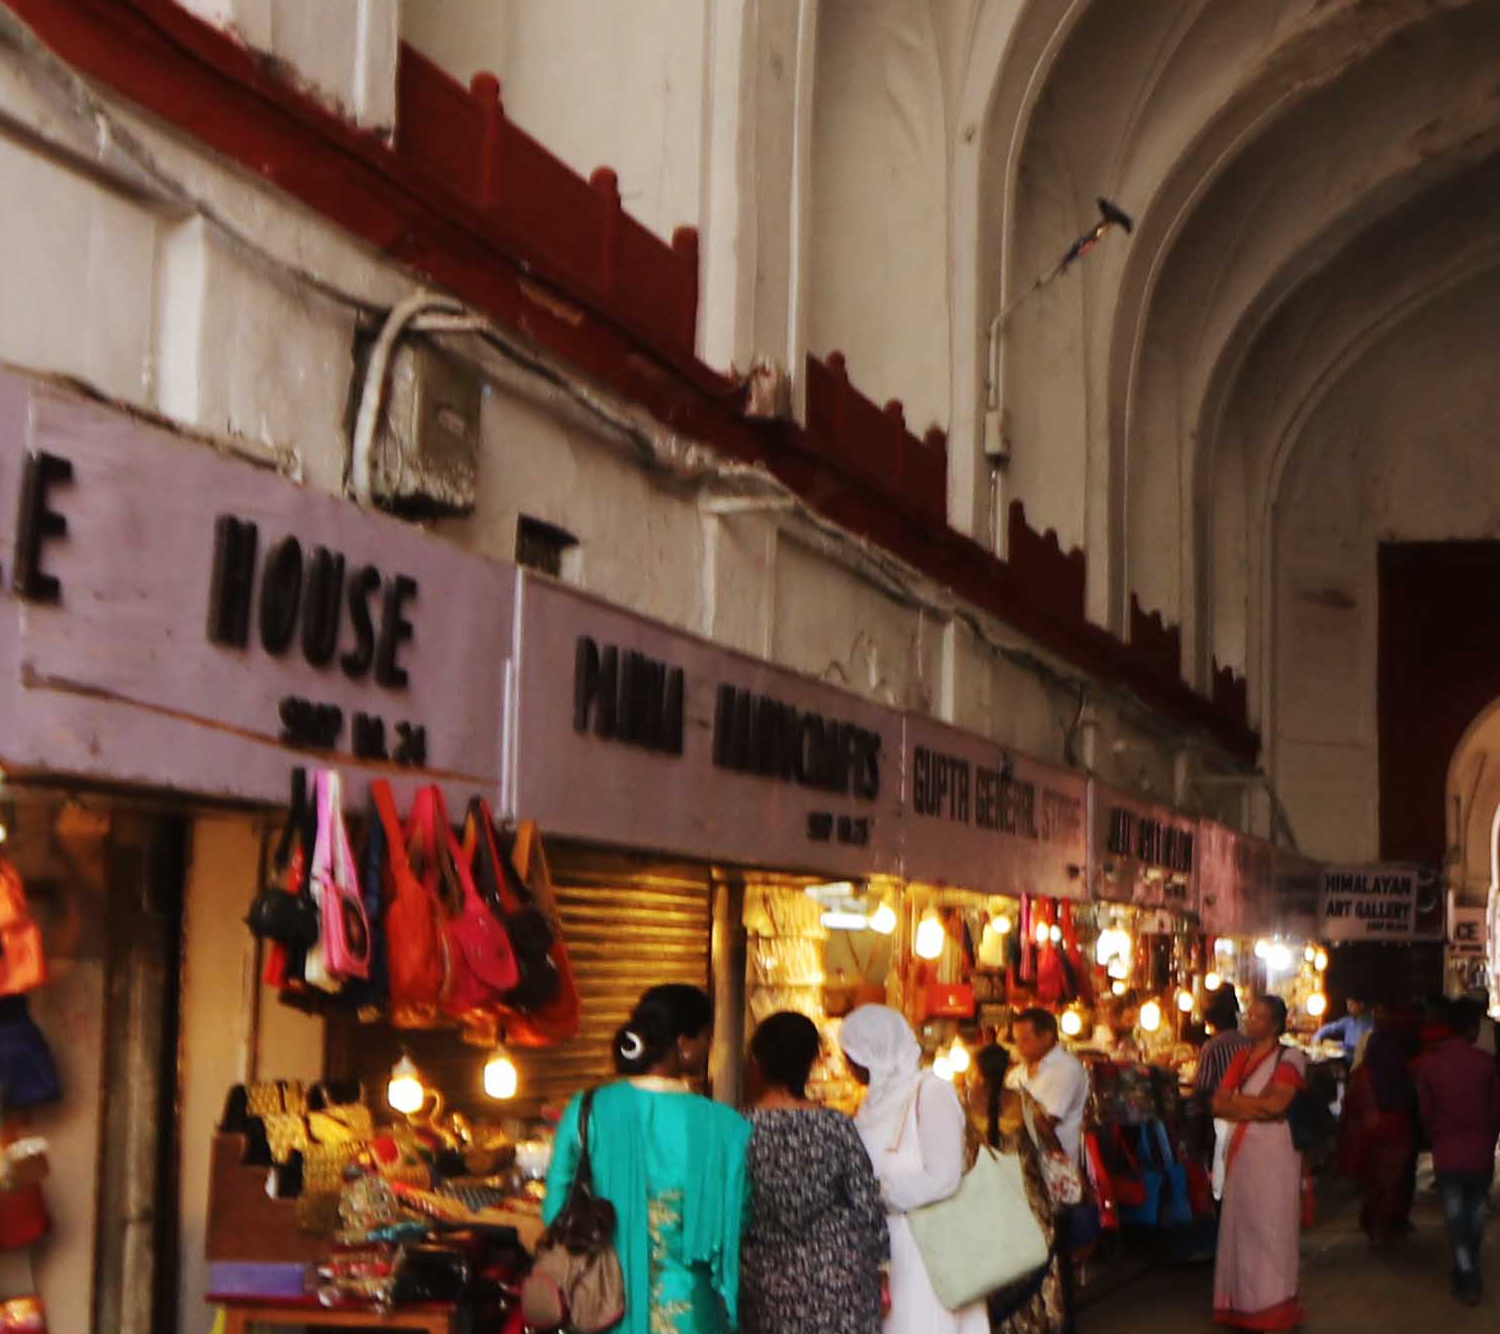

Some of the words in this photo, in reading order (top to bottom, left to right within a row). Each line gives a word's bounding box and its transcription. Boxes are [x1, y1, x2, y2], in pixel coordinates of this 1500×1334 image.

[207, 513, 419, 691] HOUSE
[913, 746, 969, 823] GUPTA
[1325, 874, 1411, 894] HIMALAYAN
[1326, 900, 1351, 918] ART
[1355, 901, 1411, 920] GALLERY
